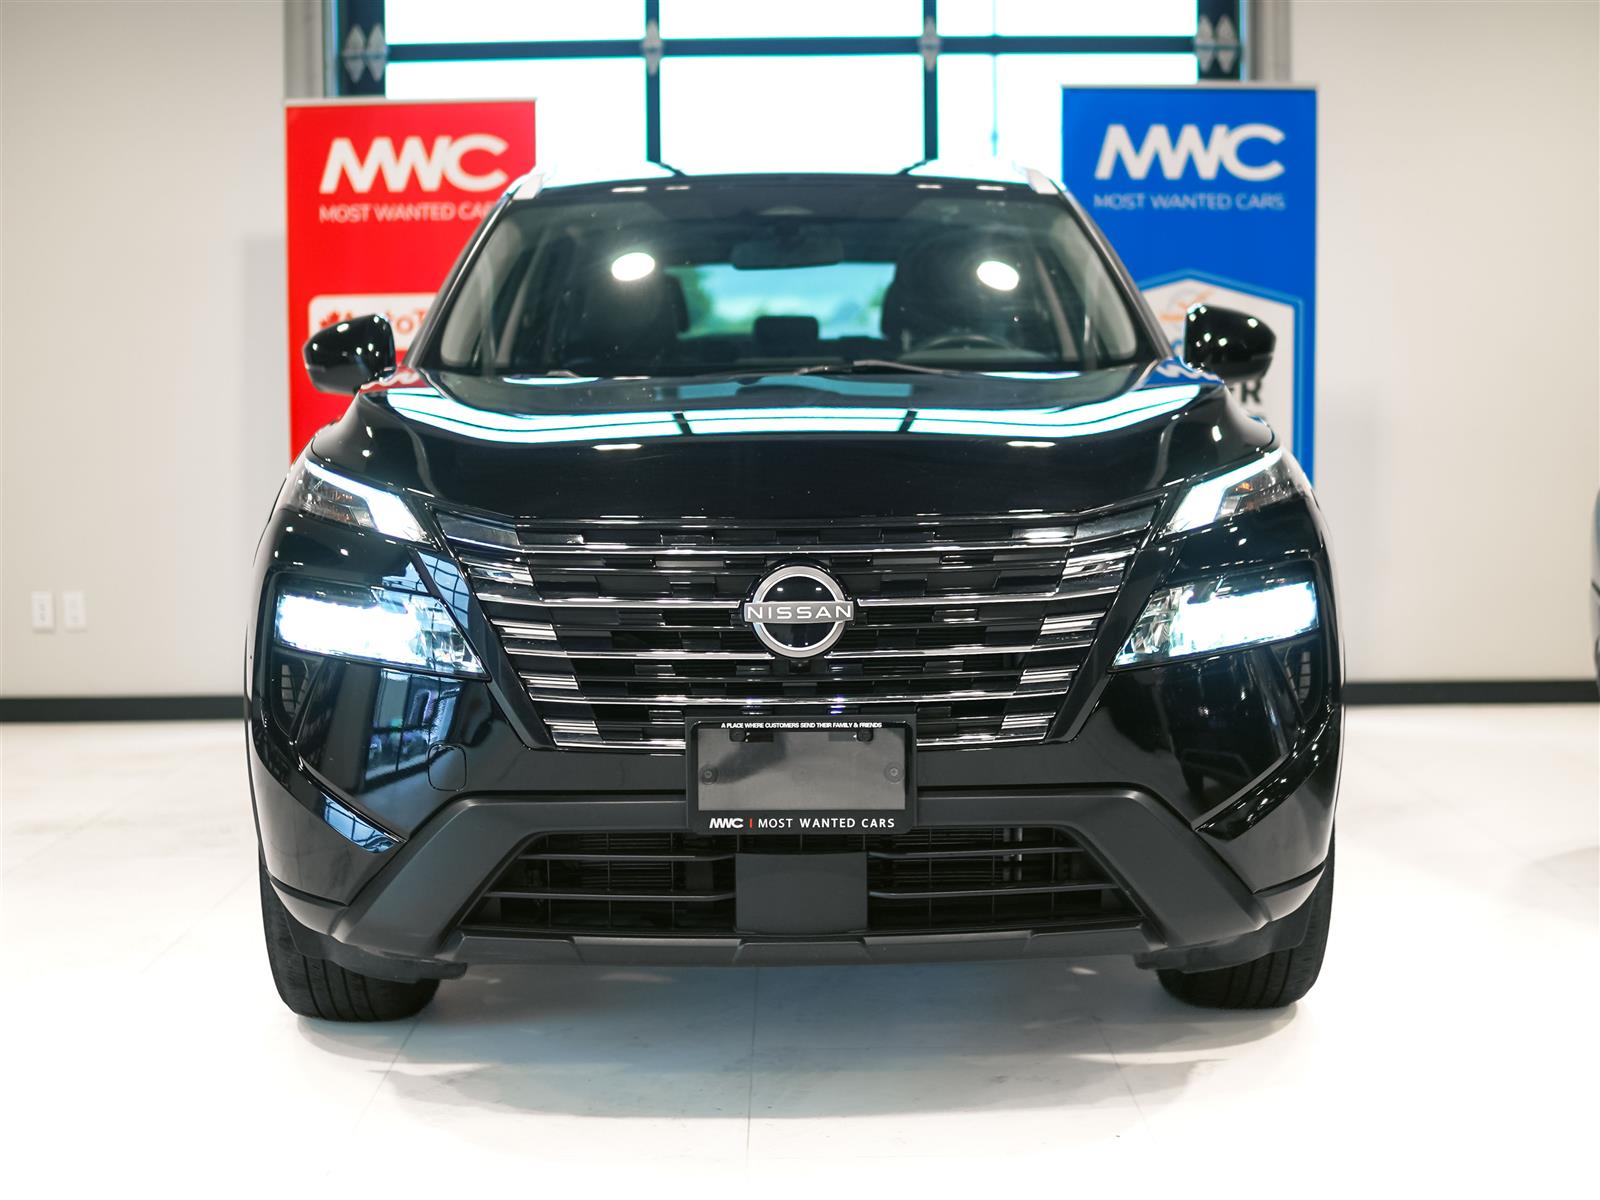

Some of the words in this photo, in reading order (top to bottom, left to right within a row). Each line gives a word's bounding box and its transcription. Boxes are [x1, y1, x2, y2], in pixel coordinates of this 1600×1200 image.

[1094, 123, 1286, 181] MWC
[319, 133, 509, 194] MWC
[1094, 193, 1145, 210] MOST
[1150, 193, 1233, 210] WANTED
[1235, 193, 1285, 210] CARS
[319, 205, 370, 223] MOST
[374, 203, 456, 222] WANTED
[747, 605, 851, 619] NISSAN
[709, 817, 744, 829] MWC
[758, 818, 793, 828] MOST
[799, 818, 856, 828] WANTED
[861, 818, 895, 828] CARS
